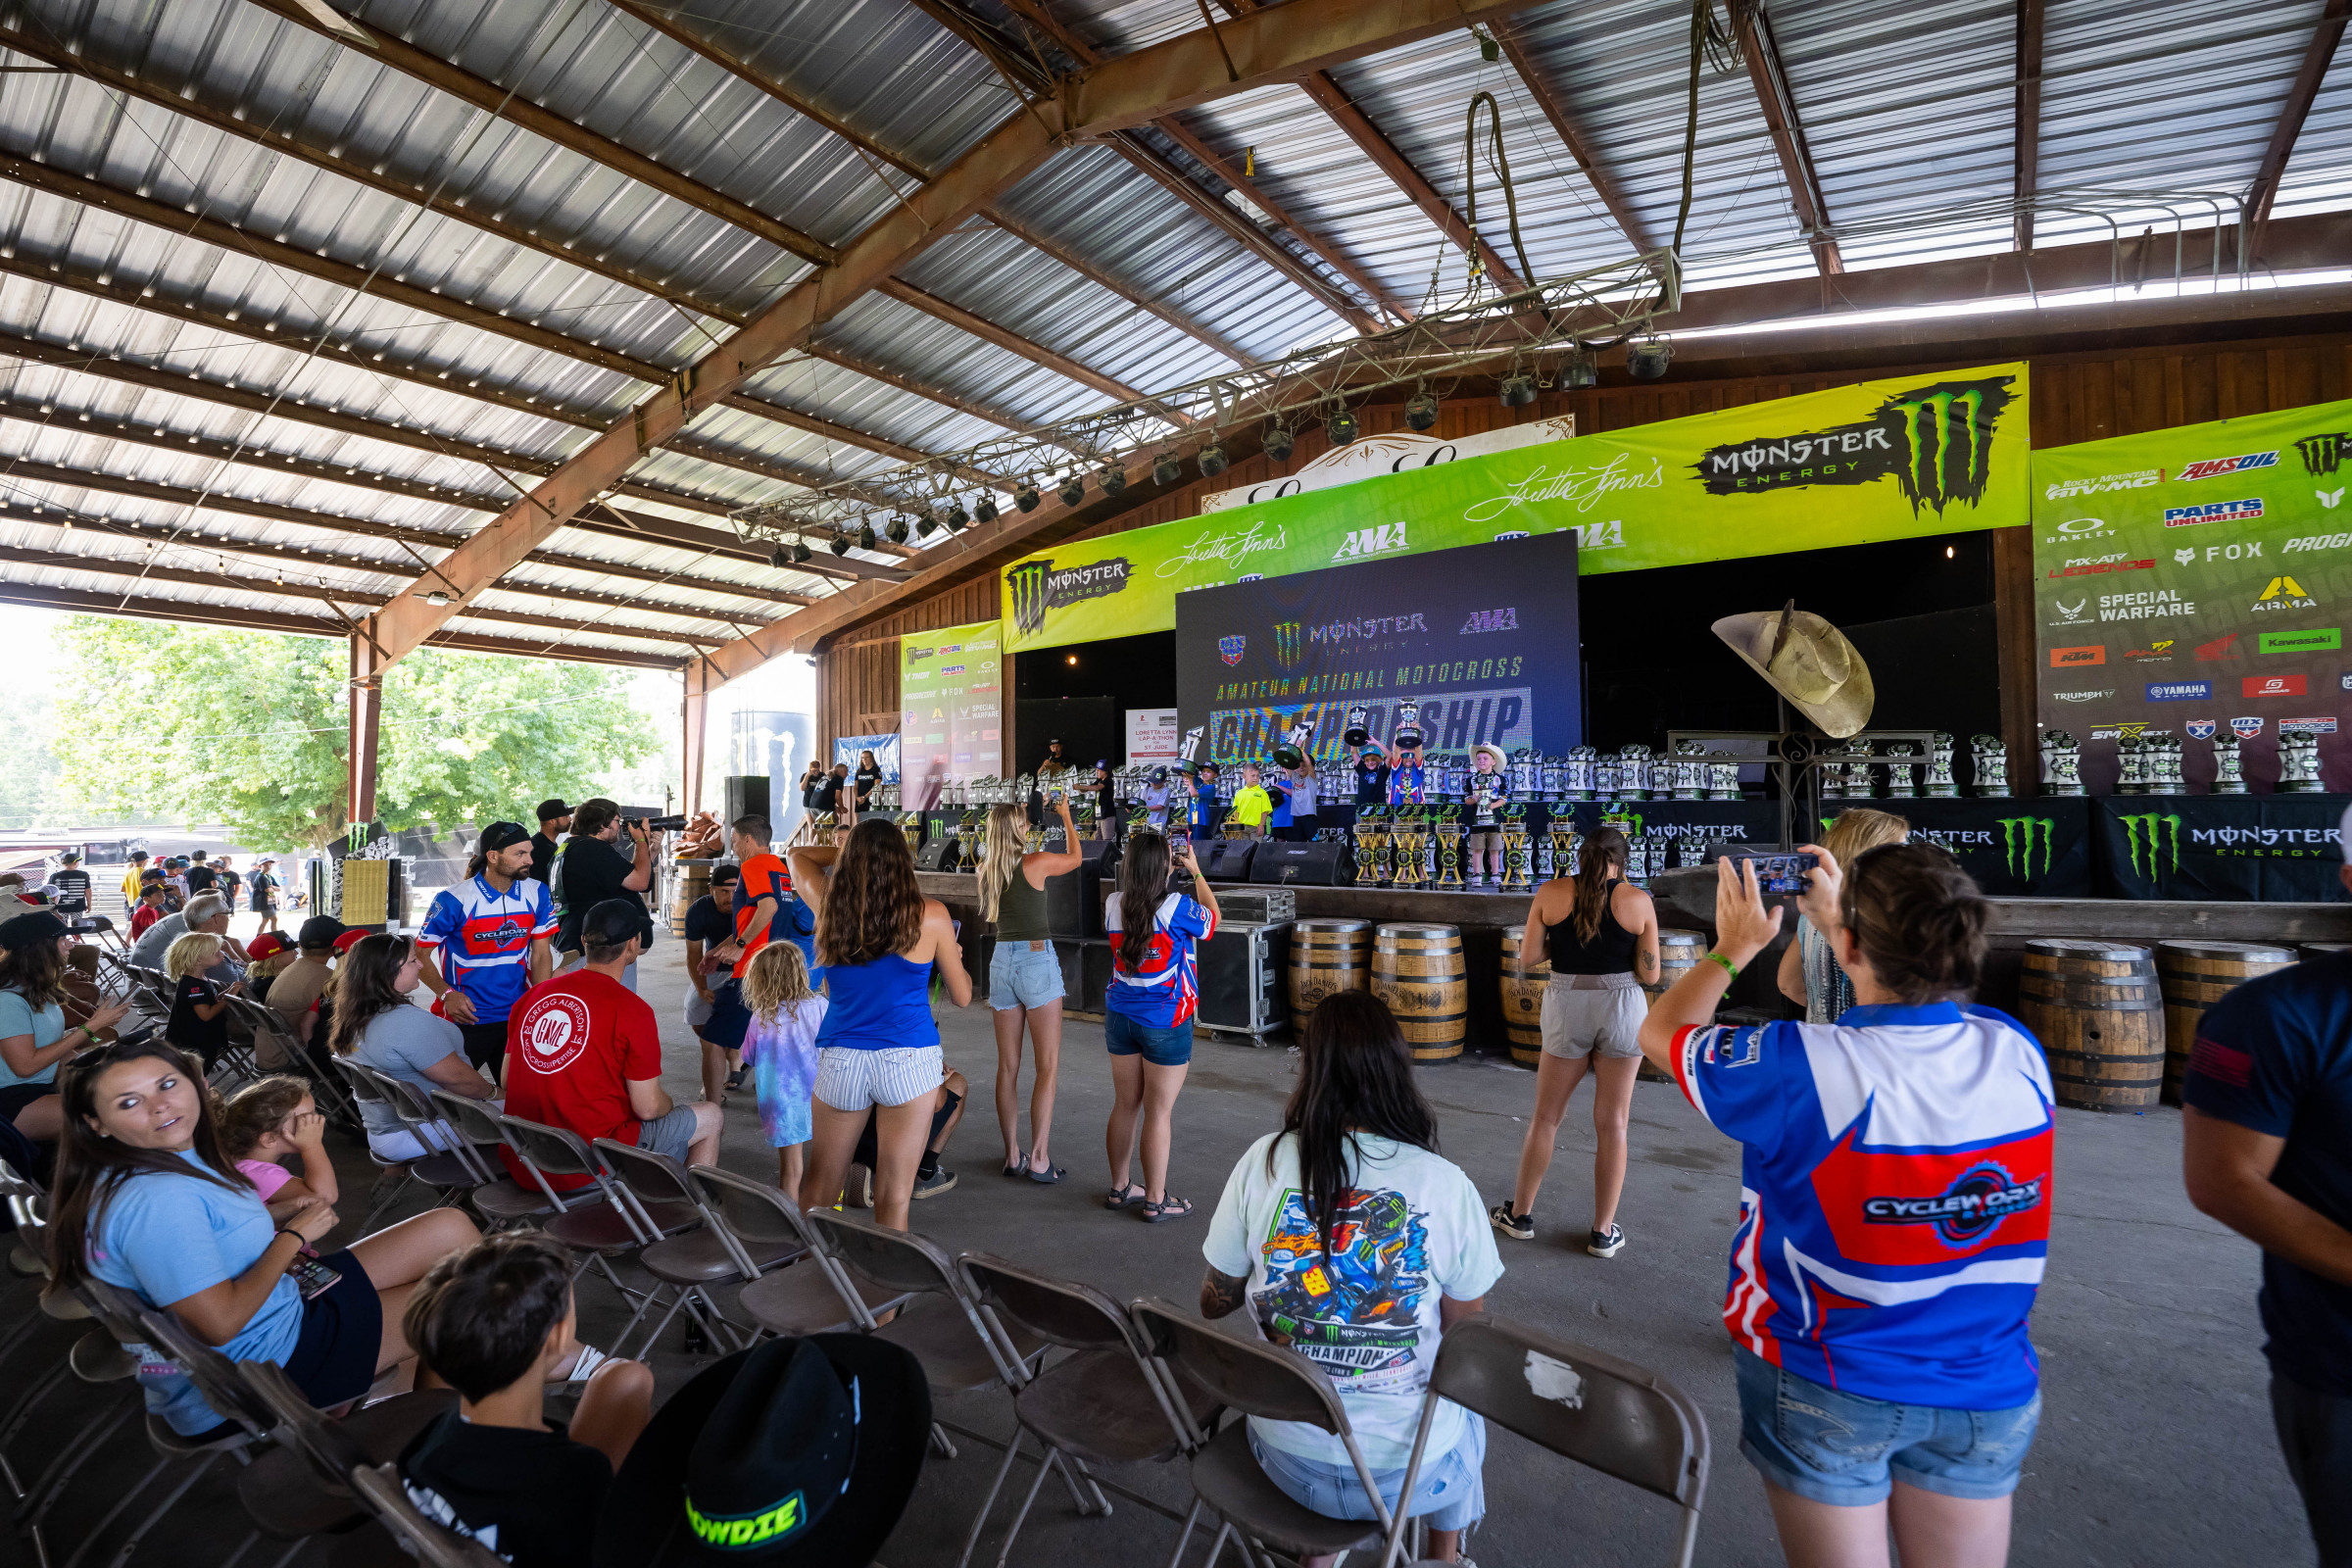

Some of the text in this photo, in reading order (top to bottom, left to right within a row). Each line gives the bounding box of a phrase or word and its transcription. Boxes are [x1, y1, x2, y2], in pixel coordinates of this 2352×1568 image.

[1712, 426, 1891, 475] MONSTER
[1737, 461, 1858, 488] ENERGY
[2178, 451, 2279, 481] AMSOIL
[1464, 452, 1663, 522] Loretta Lynn's
[2063, 477, 2097, 488] ROCKY
[2099, 468, 2158, 483] MOUNTAIN
[2165, 498, 2263, 520] PARTS
[2165, 509, 2263, 527] UNLIMITED
[1331, 521, 1410, 559] AMA
[2046, 529, 2116, 544] OAKLEY
[2206, 541, 2263, 563] FOX
[1048, 563, 1125, 591] MONSTER
[2048, 559, 2156, 579] LEGENDS
[1058, 584, 1112, 599] ENERGY
[2099, 589, 2181, 609] SPECIAL
[2099, 602, 2195, 622] WARFARE
[2250, 598, 2319, 612] ARMA
[1309, 612, 1428, 645] MONSTER
[1459, 608, 1519, 633] AMA
[2268, 635, 2331, 648] Kawasaki
[2060, 651, 2095, 662] KTM
[911, 664, 965, 680] THOR PARTS
[1215, 656, 1523, 702] AMATEUR NATIONAL MOTOCROSS
[949, 687, 963, 699] FOX
[2053, 690, 2102, 701] TRIUMPH
[2163, 684, 2206, 695] YAMAHA
[972, 704, 996, 712] SPECIAL
[972, 710, 999, 719] WARFARE
[1215, 696, 1523, 760] CHAMPOSHIP
[2279, 721, 2336, 730] MOTOCROSS
[1646, 822, 1747, 840] MONSTER
[2191, 825, 2345, 847] MONSTER
[2216, 849, 2323, 858] ENERGY
[528, 998, 585, 1032] GREGG ALBERTSON
[524, 1025, 533, 1034] 20
